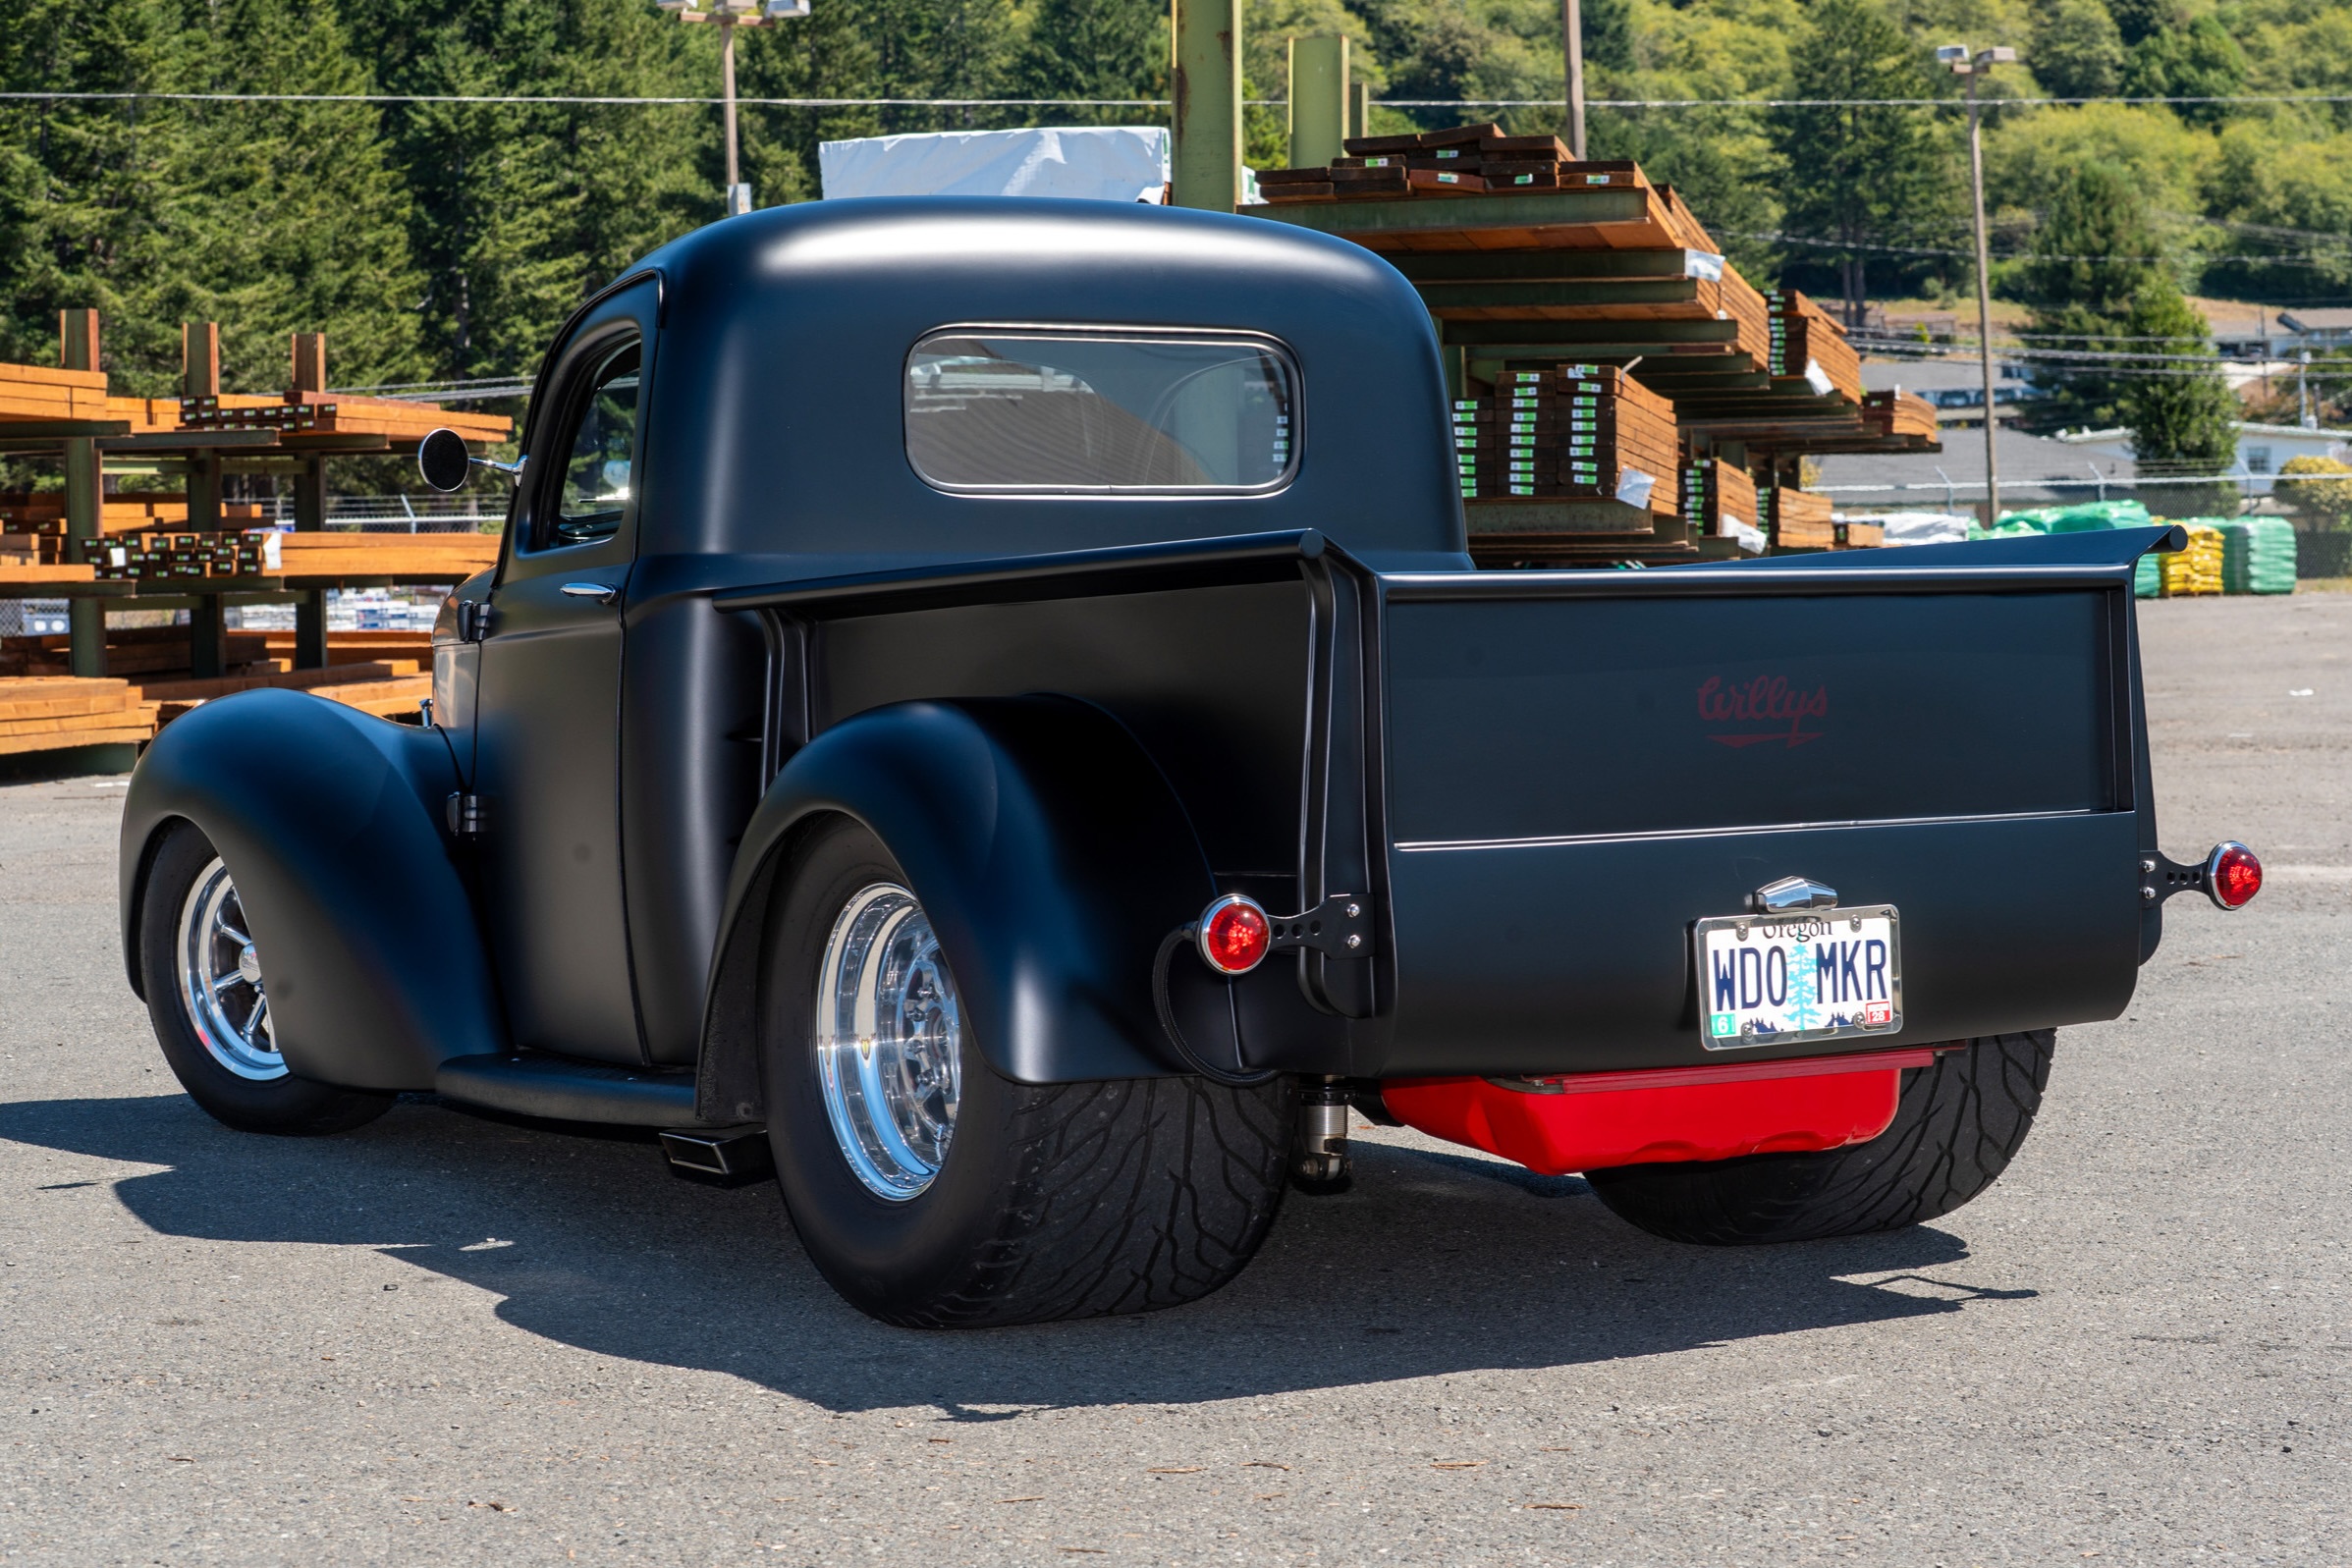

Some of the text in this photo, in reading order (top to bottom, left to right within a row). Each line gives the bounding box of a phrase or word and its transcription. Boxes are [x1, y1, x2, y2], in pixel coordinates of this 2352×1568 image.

[1697, 675, 1828, 748] Willys
[1763, 921, 1832, 943] Oregon
[1714, 940, 1887, 1011] WDO MKR
[1718, 1016, 1728, 1033] 6
